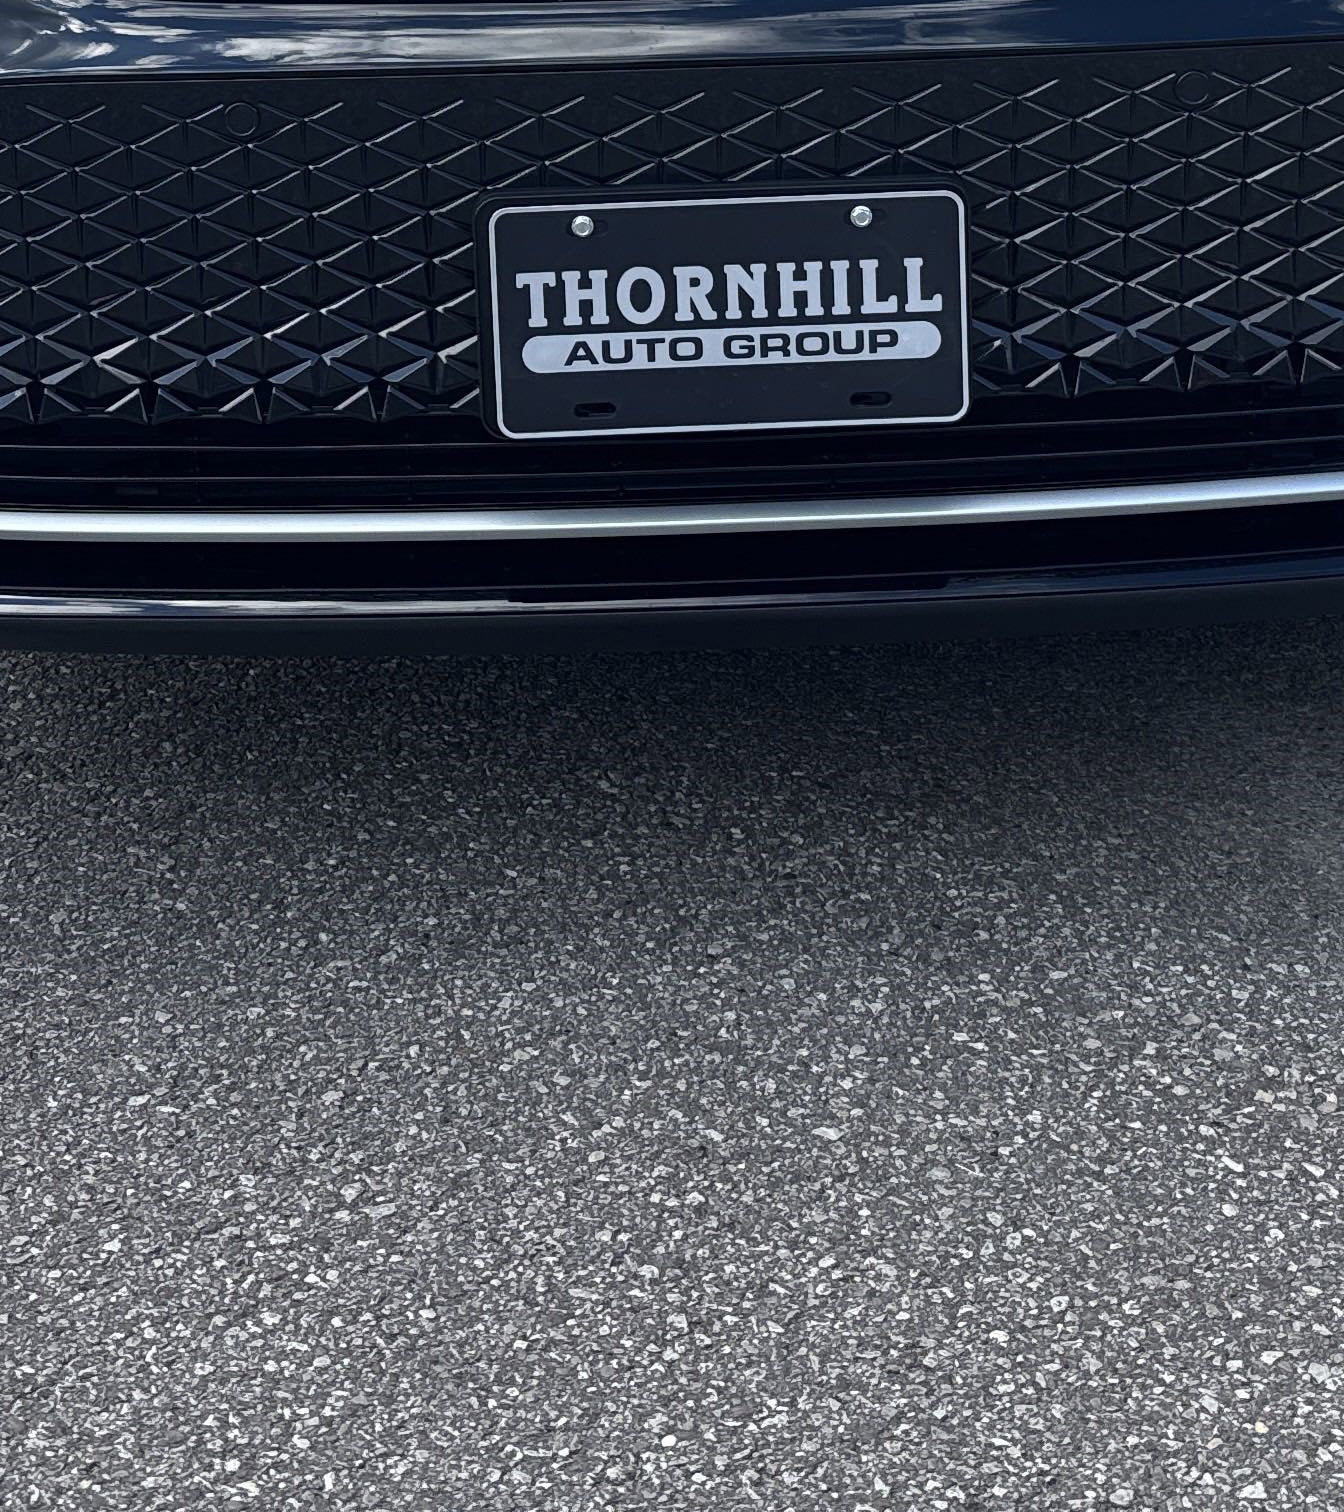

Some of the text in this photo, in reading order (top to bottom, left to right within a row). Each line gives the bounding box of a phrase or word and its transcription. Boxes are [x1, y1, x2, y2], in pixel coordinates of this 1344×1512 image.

[515, 257, 943, 328] THORNHILL
[564, 328, 899, 366] AUTO GROUP
